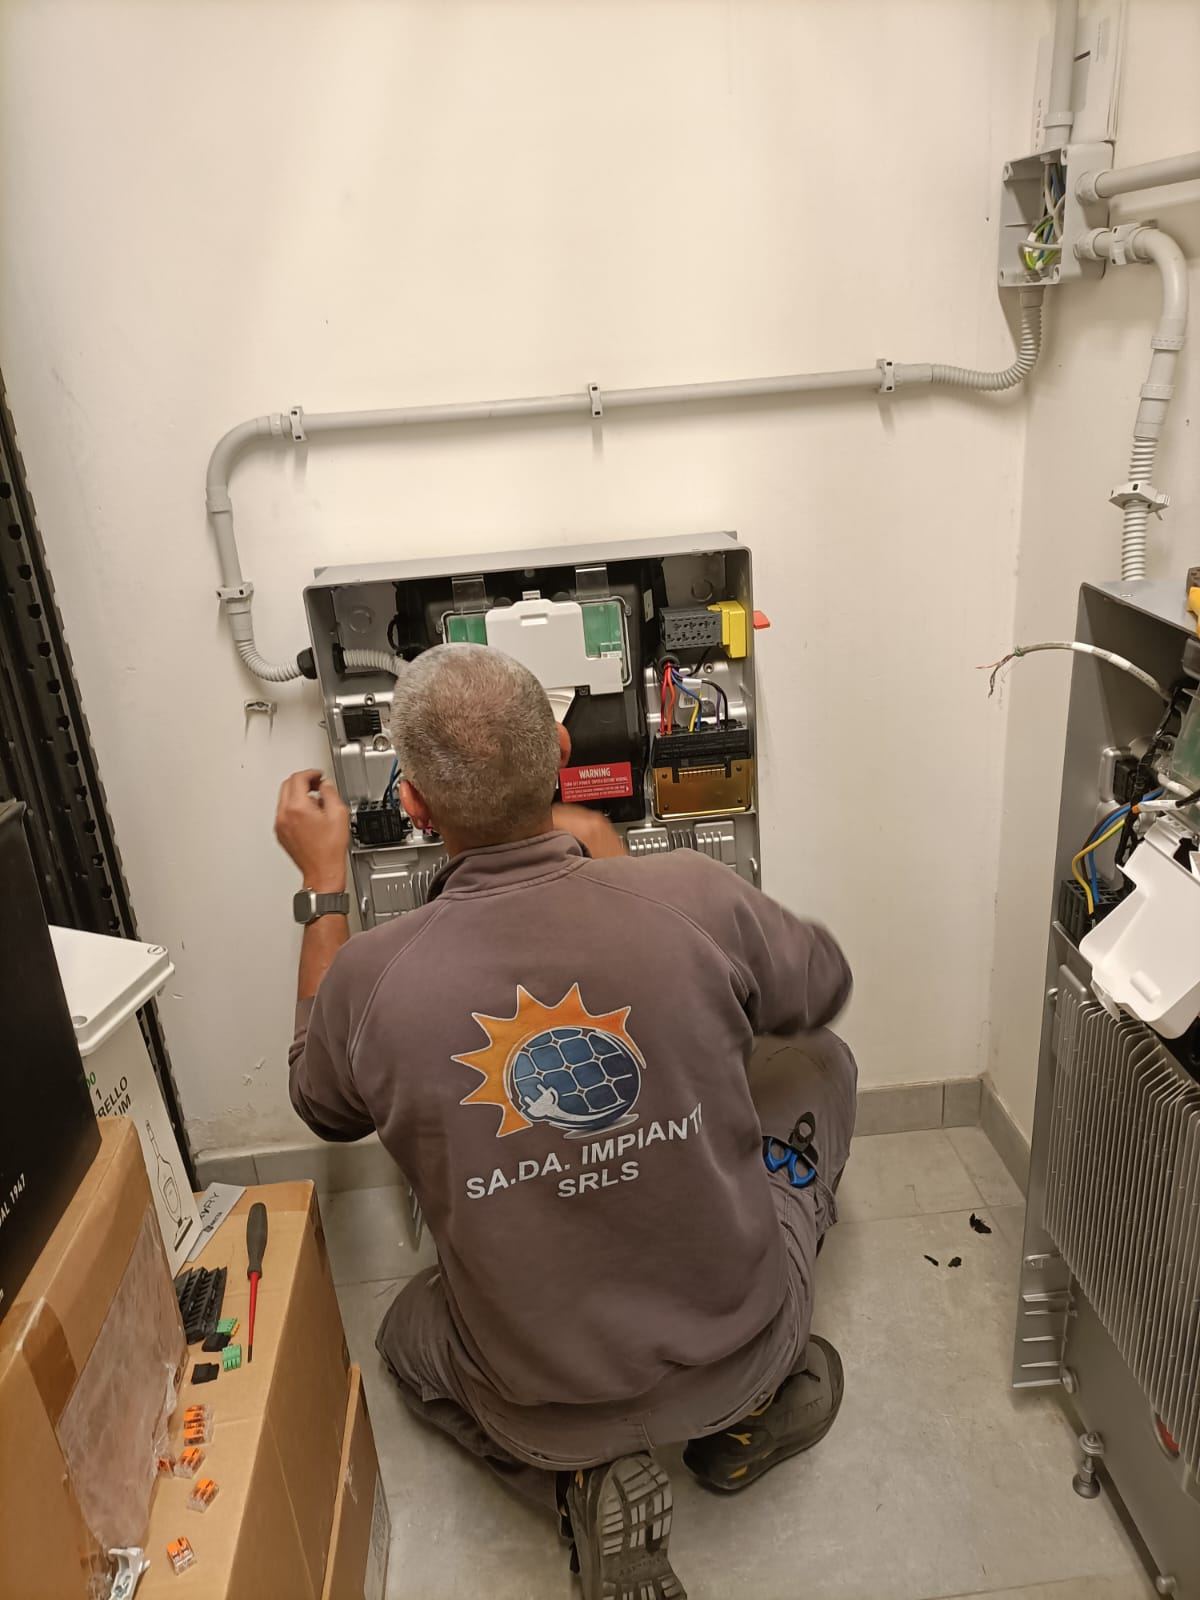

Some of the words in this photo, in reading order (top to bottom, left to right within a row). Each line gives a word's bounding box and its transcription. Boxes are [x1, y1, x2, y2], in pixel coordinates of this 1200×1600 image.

[579, 767, 611, 779] WARNING
[95, 1076, 128, 1117] RELLO
[466, 1152, 571, 1199] SA.DA.
[582, 1102, 702, 1165] IMPIANTI
[557, 1160, 639, 1198] SRLS
